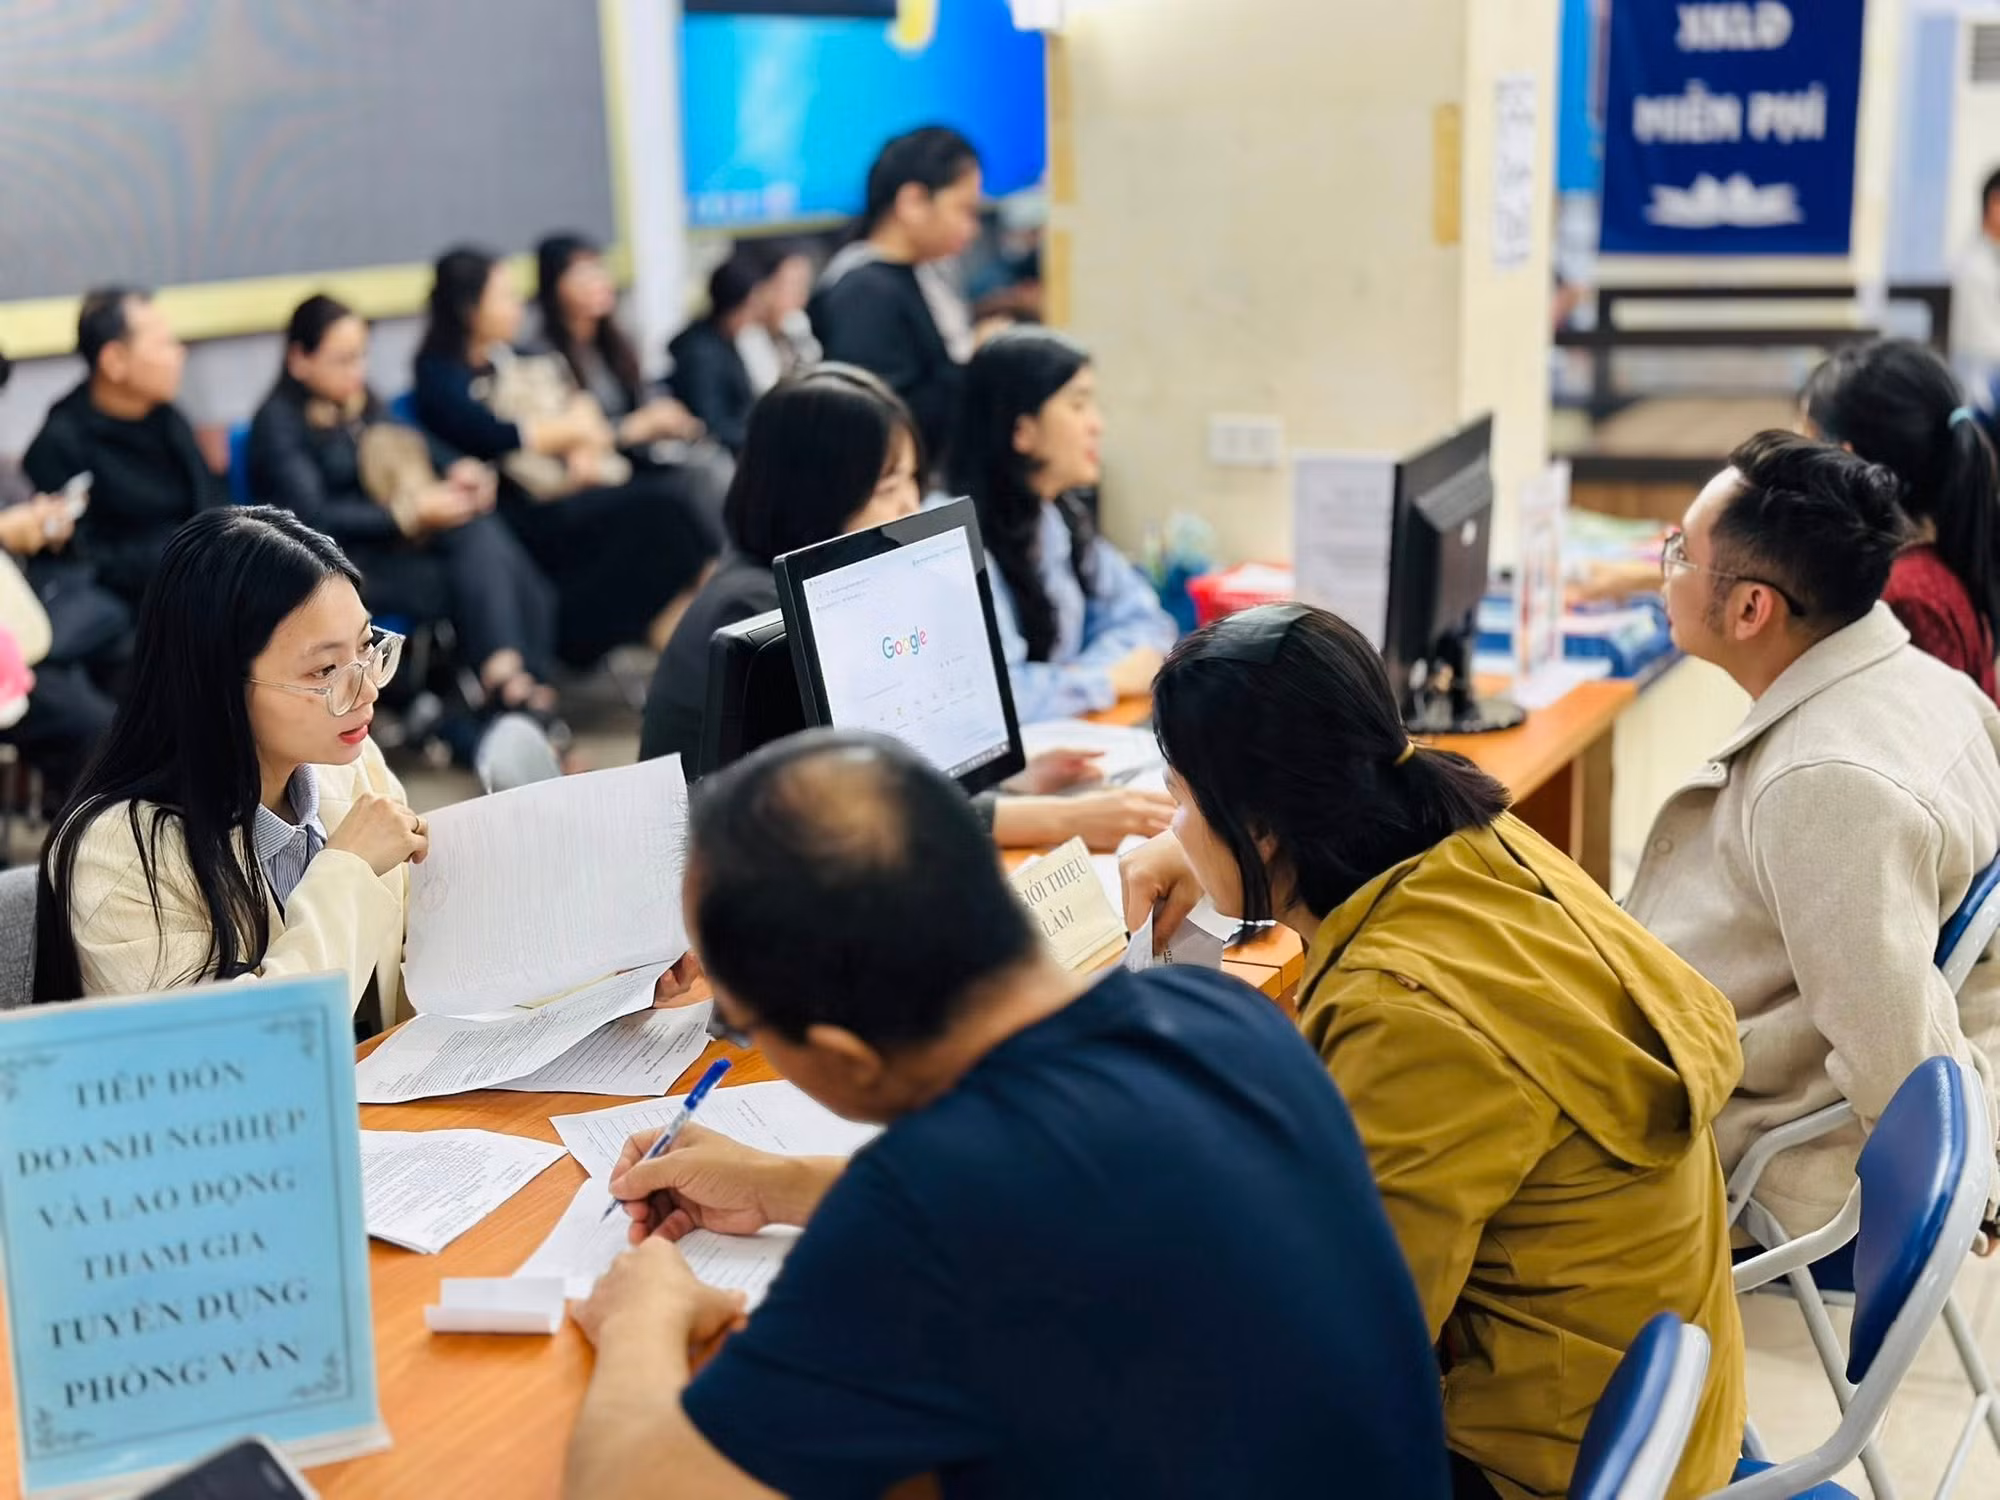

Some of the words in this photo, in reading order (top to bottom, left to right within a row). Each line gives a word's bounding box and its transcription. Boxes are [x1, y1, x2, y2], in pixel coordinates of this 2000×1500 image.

[882, 627, 927, 659] Google
[1042, 905, 1075, 938] LÀM
[17, 1131, 154, 1177] DOANH
[165, 1107, 307, 1149] NGHIỆP
[38, 1191, 89, 1229] VÀ
[100, 1189, 180, 1221] LAO
[78, 1241, 191, 1282] THAM
[202, 1230, 267, 1261] GIA
[196, 1277, 310, 1322] DỤNG
